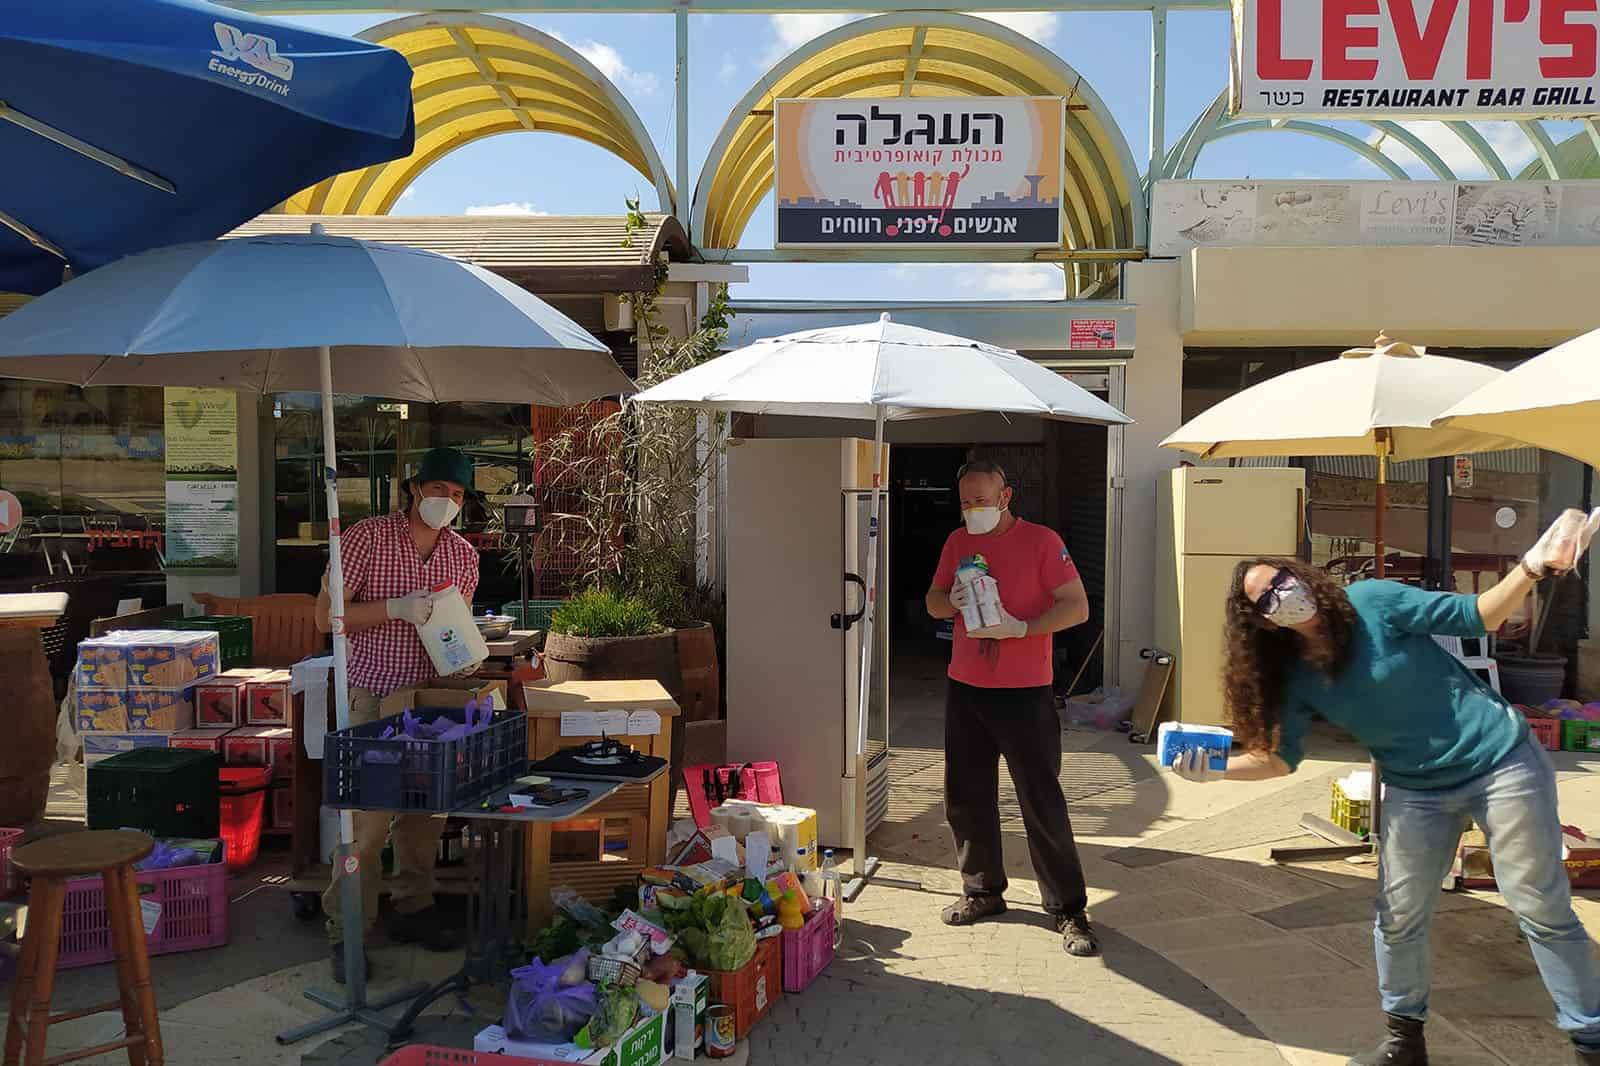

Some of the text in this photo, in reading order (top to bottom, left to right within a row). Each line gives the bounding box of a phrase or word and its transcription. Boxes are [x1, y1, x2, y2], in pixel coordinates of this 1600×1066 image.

[1256, 0, 1598, 80] LEVI'S
[1259, 91, 1304, 106] כשר
[1322, 86, 1596, 108] RESTAURANT BAR GRILL
[835, 105, 1003, 145] העגלה
[834, 148, 1003, 166] מכולת קואופרטיבית
[1368, 190, 1448, 215] Levi's
[821, 214, 1017, 233] אנשים לפני רווחים
